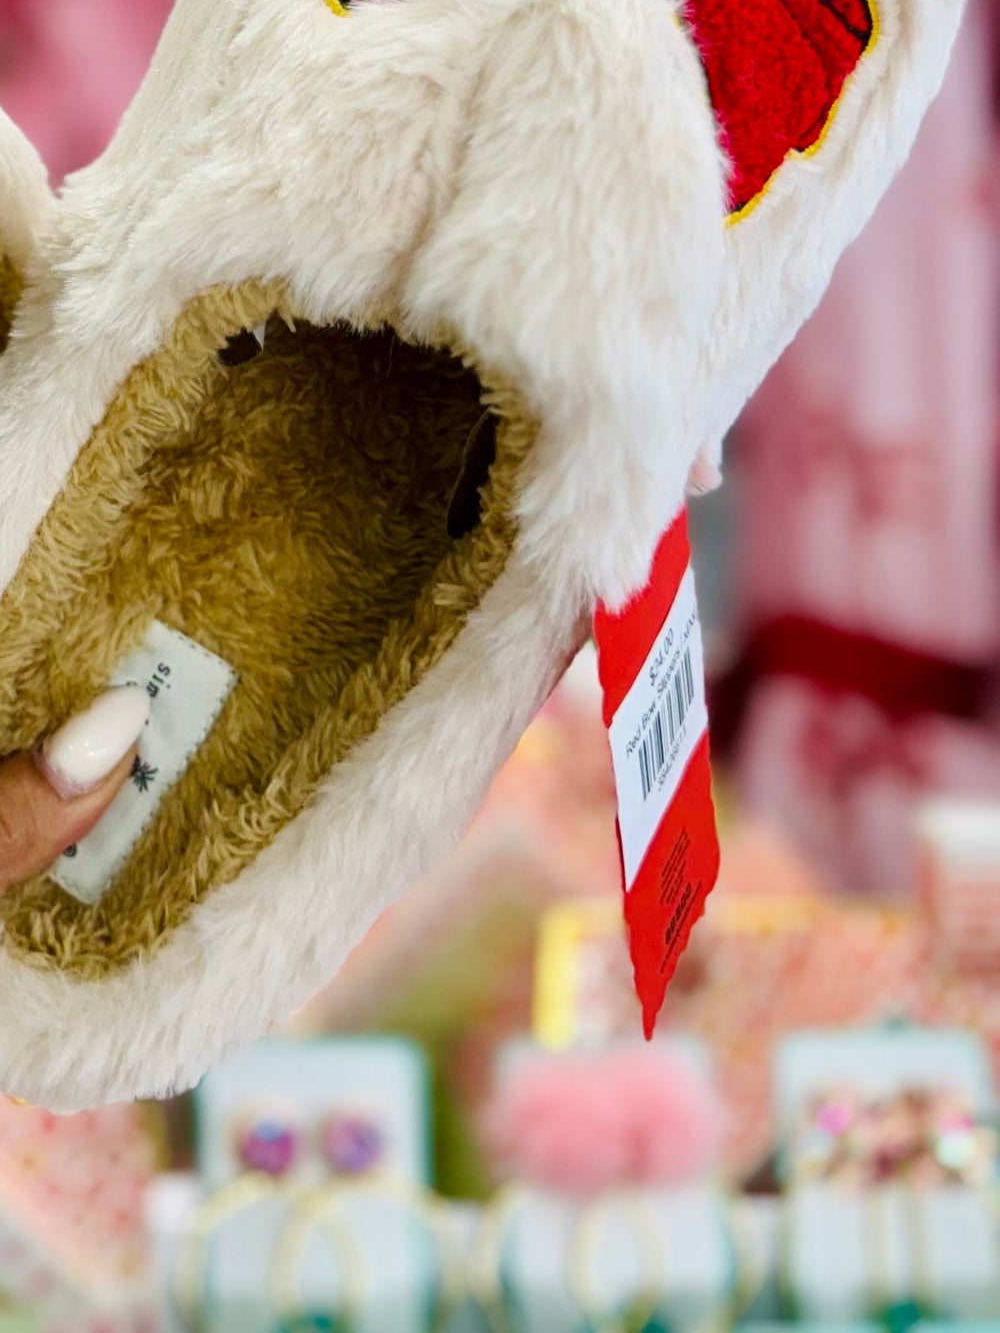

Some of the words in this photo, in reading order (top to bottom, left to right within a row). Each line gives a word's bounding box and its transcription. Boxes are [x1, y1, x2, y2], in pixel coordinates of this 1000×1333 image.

[146, 662, 171, 698] sim
[625, 724, 642, 760] Red
[641, 701, 658, 730] Bow
